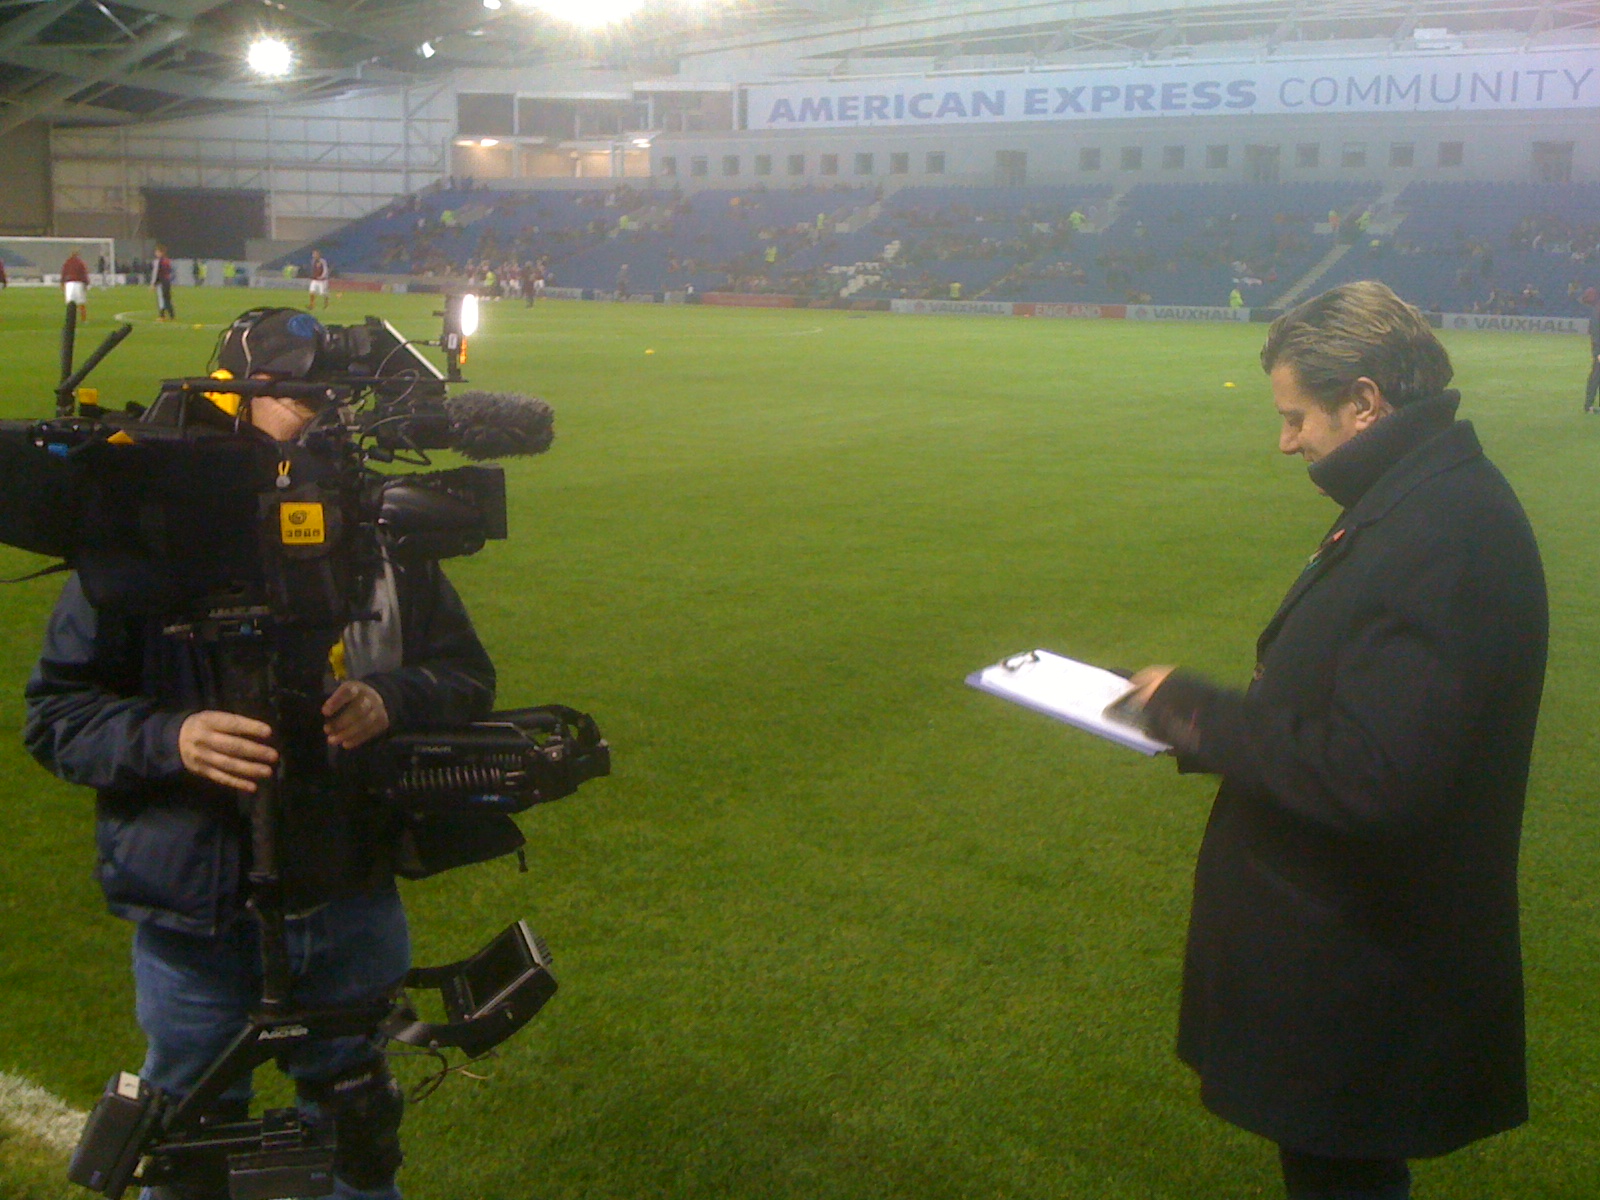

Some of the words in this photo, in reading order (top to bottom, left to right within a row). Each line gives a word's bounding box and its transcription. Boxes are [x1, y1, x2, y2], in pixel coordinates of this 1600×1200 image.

[768, 89, 1006, 123] AMERICAN
[1023, 79, 1257, 115] EXPRESS
[1278, 68, 1595, 108] COMMUNITY
[1153, 307, 1242, 321] VAUXHALL
[1474, 316, 1579, 333] VAUXHALL
